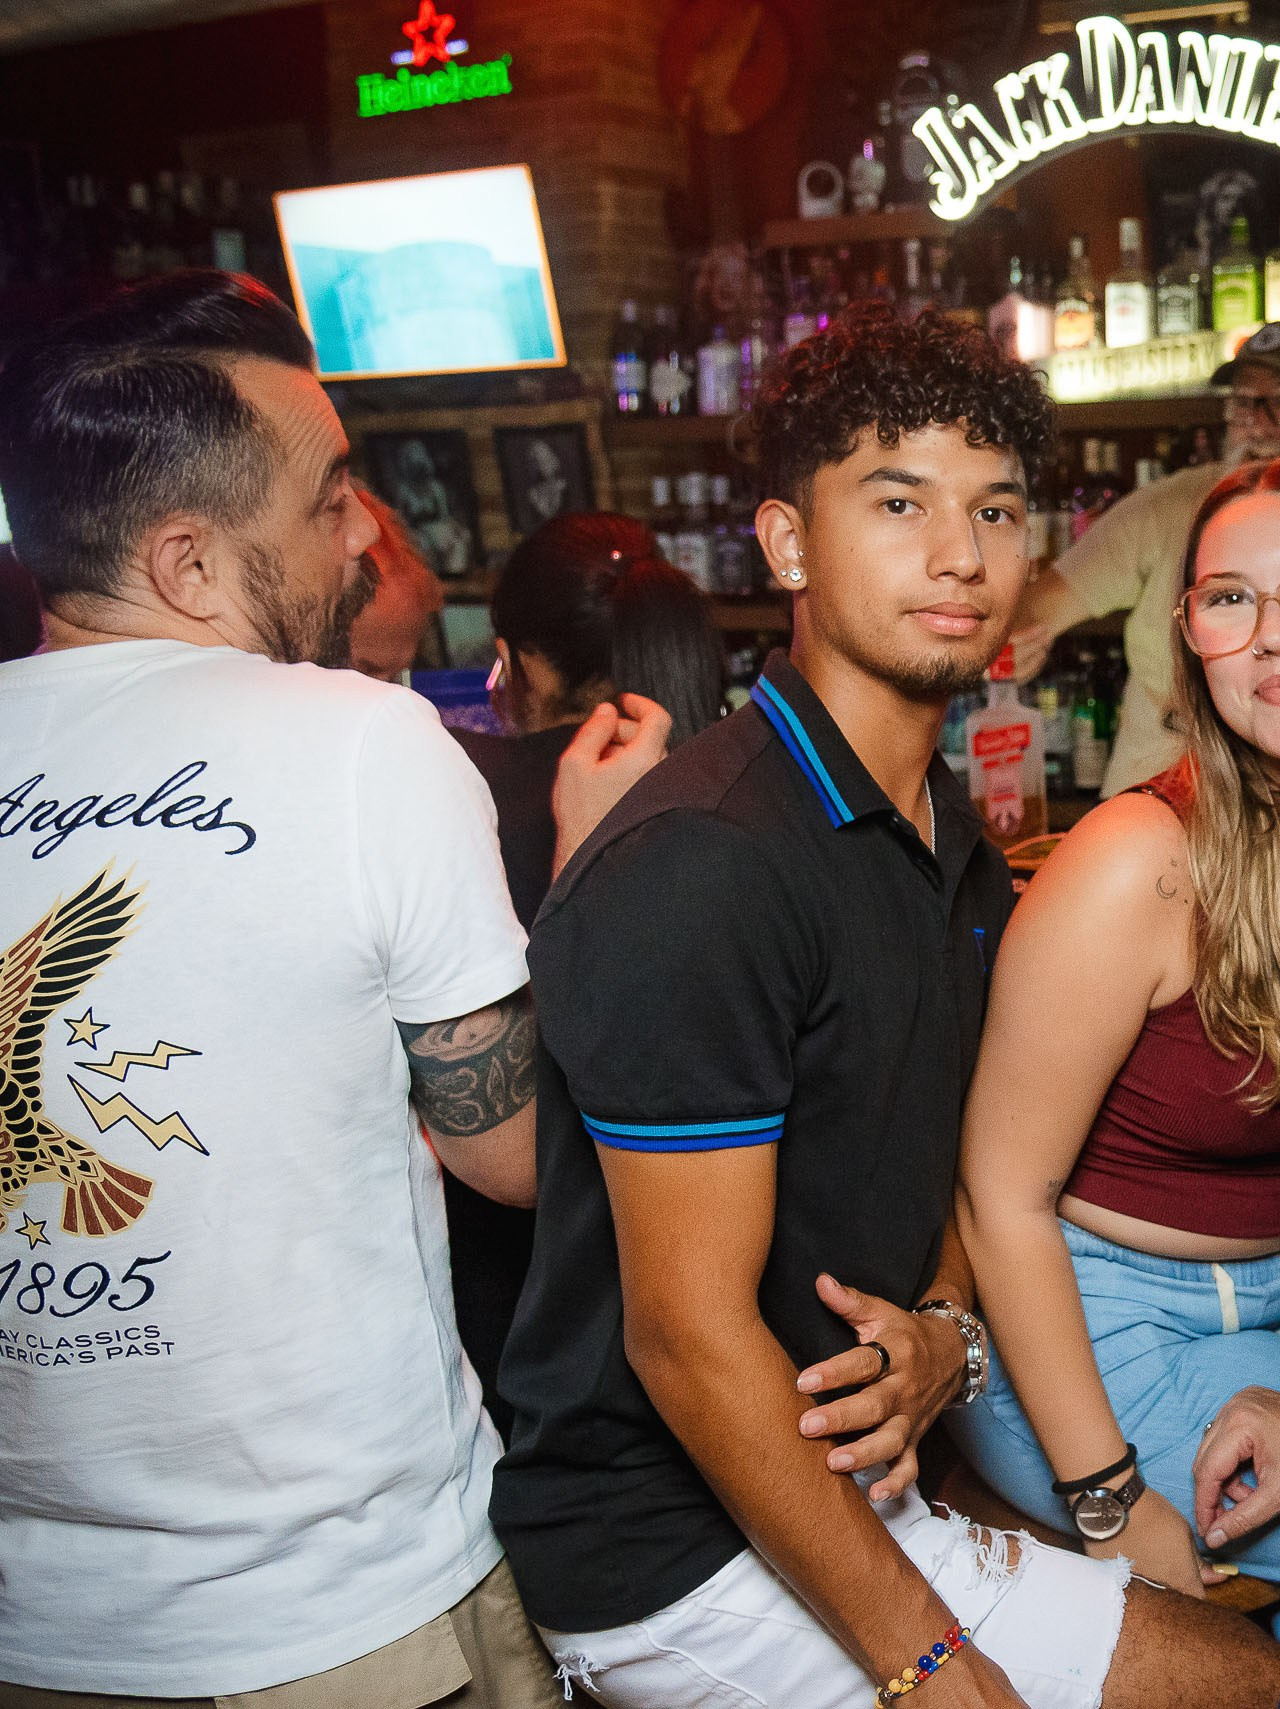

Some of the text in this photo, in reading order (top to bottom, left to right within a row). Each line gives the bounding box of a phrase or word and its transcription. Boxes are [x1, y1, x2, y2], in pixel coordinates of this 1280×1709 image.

[356, 59, 512, 117] Heineken
[912, 53, 1088, 220] JACK
[0, 761, 257, 859] Angeles
[0, 1250, 172, 1318] 1895
[0, 1342, 175, 1367] ERICA'S PAST
[26, 1325, 161, 1350] CLASSICS
